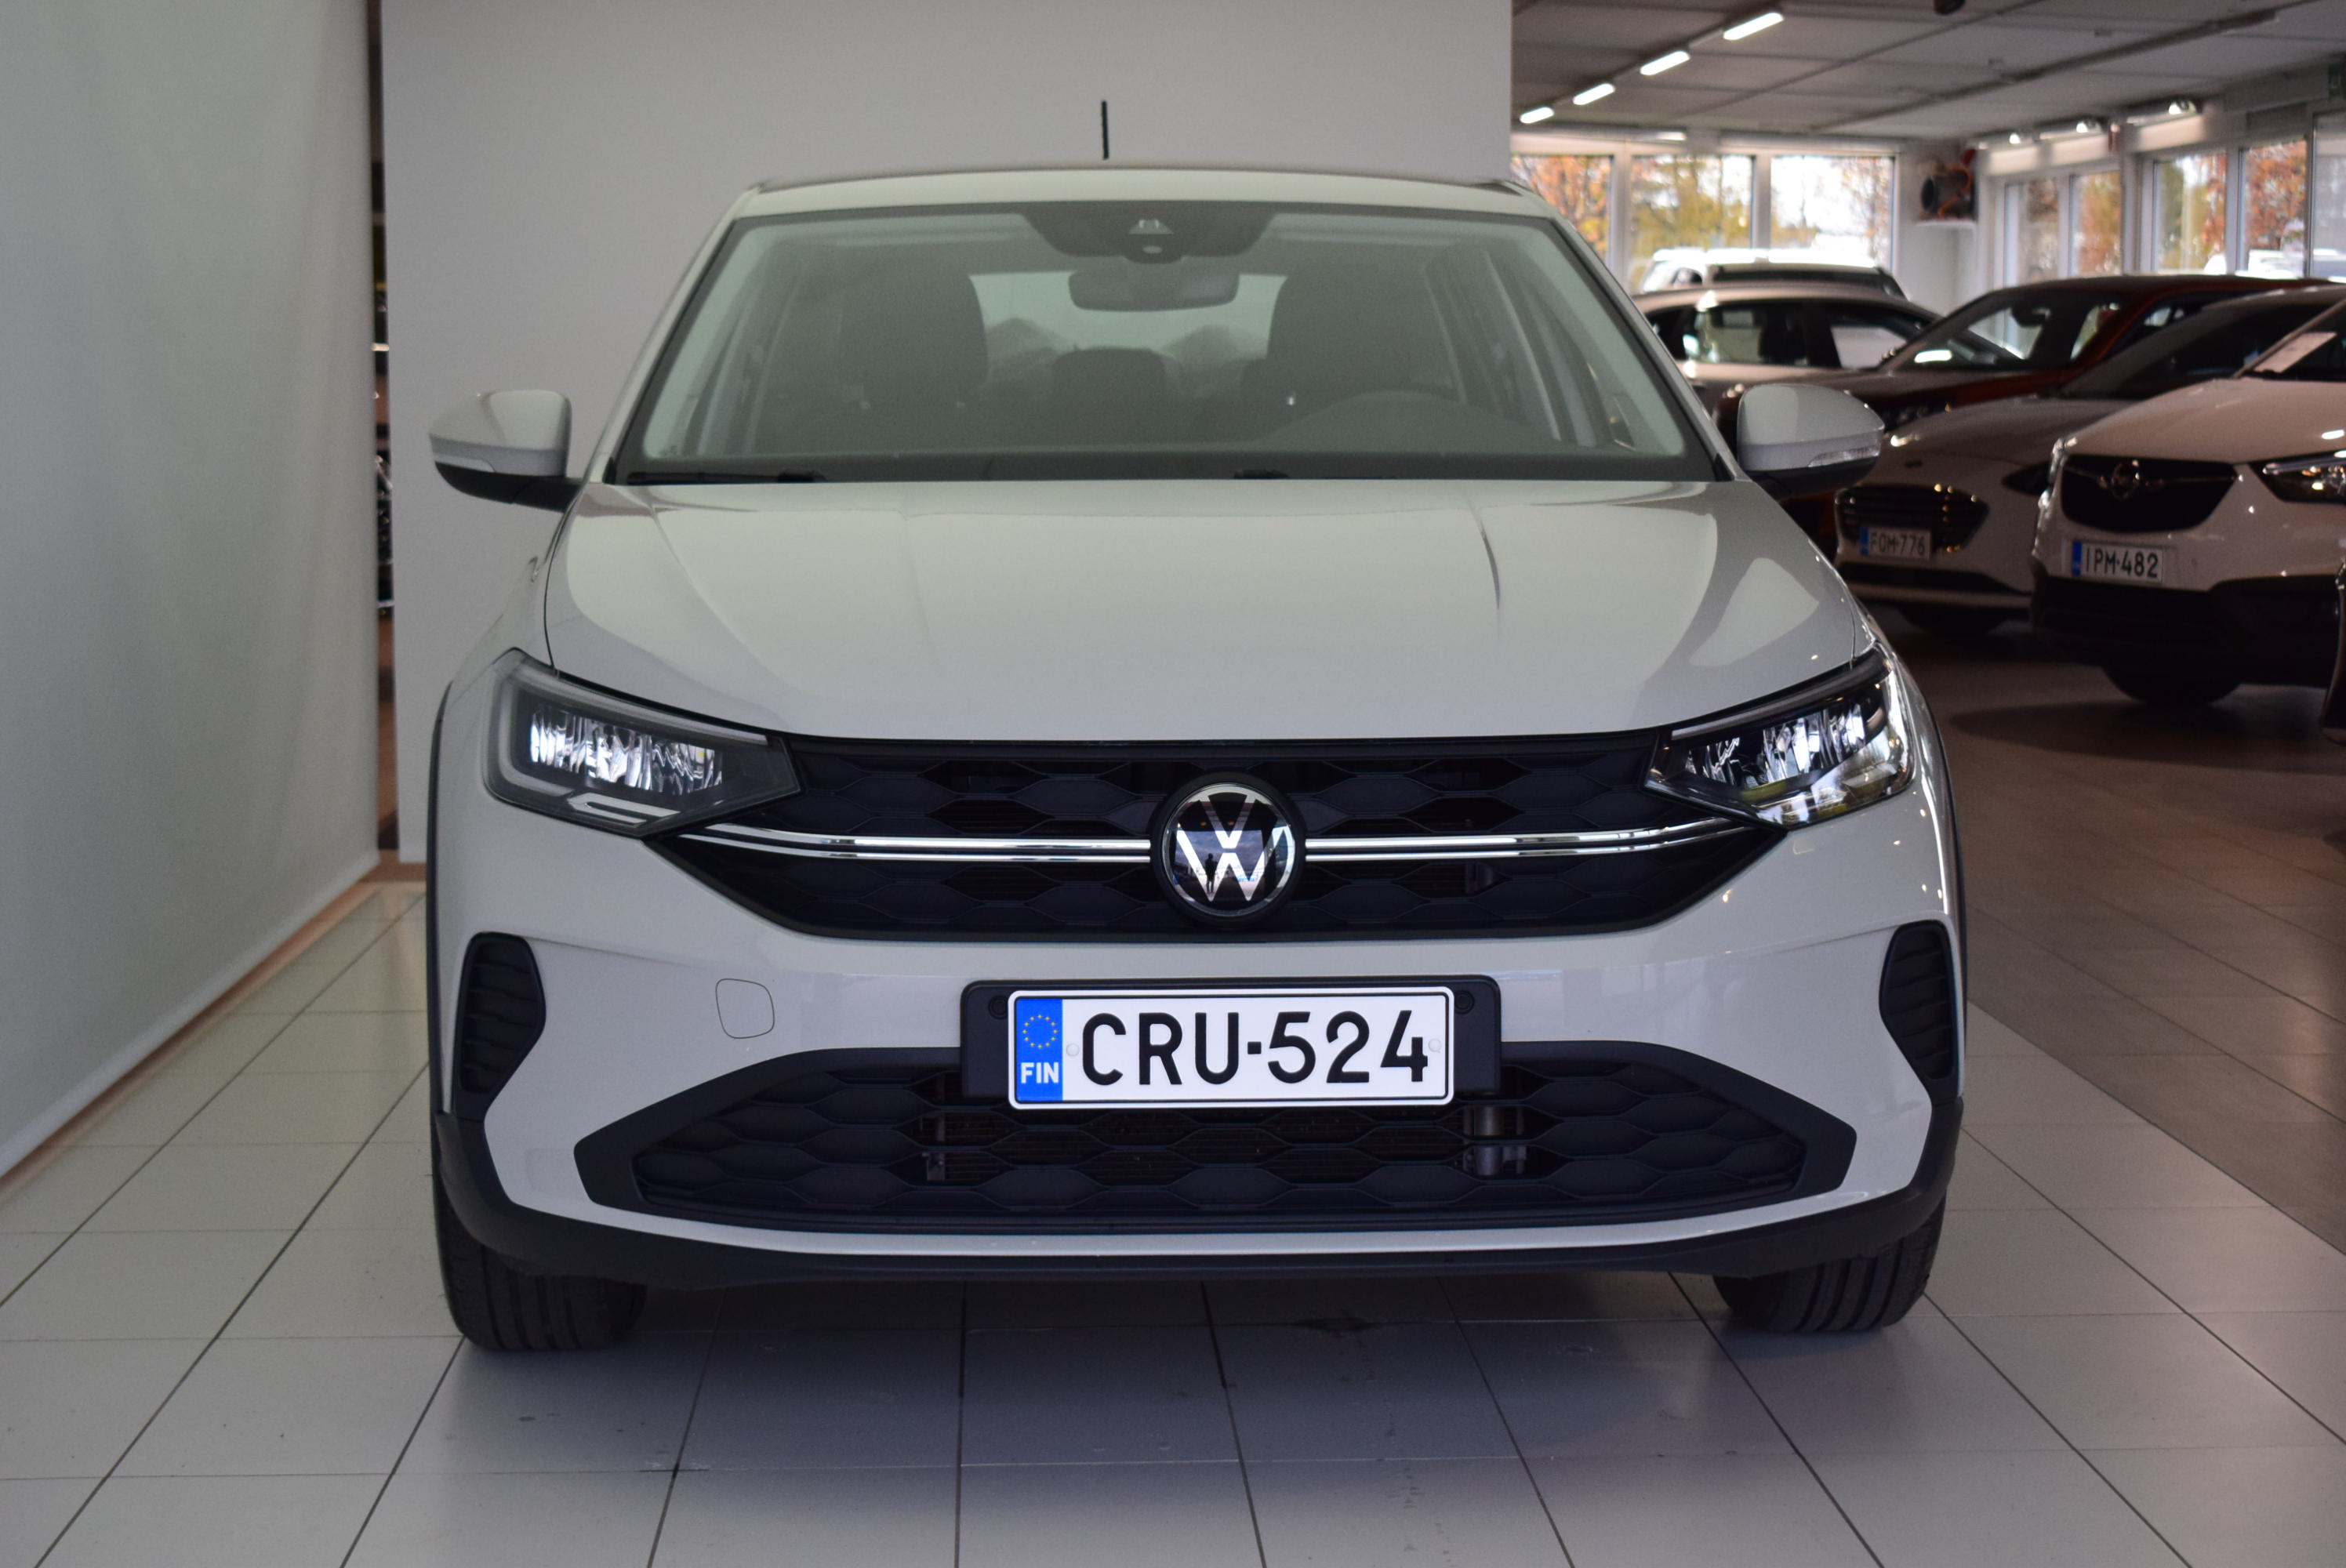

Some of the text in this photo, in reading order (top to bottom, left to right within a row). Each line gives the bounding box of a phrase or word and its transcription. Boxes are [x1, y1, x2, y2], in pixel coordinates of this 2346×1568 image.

[2086, 547, 2159, 579] IPM-482
[1082, 1009, 1429, 1086] CRU-524
[1021, 1062, 1059, 1083] FIN
